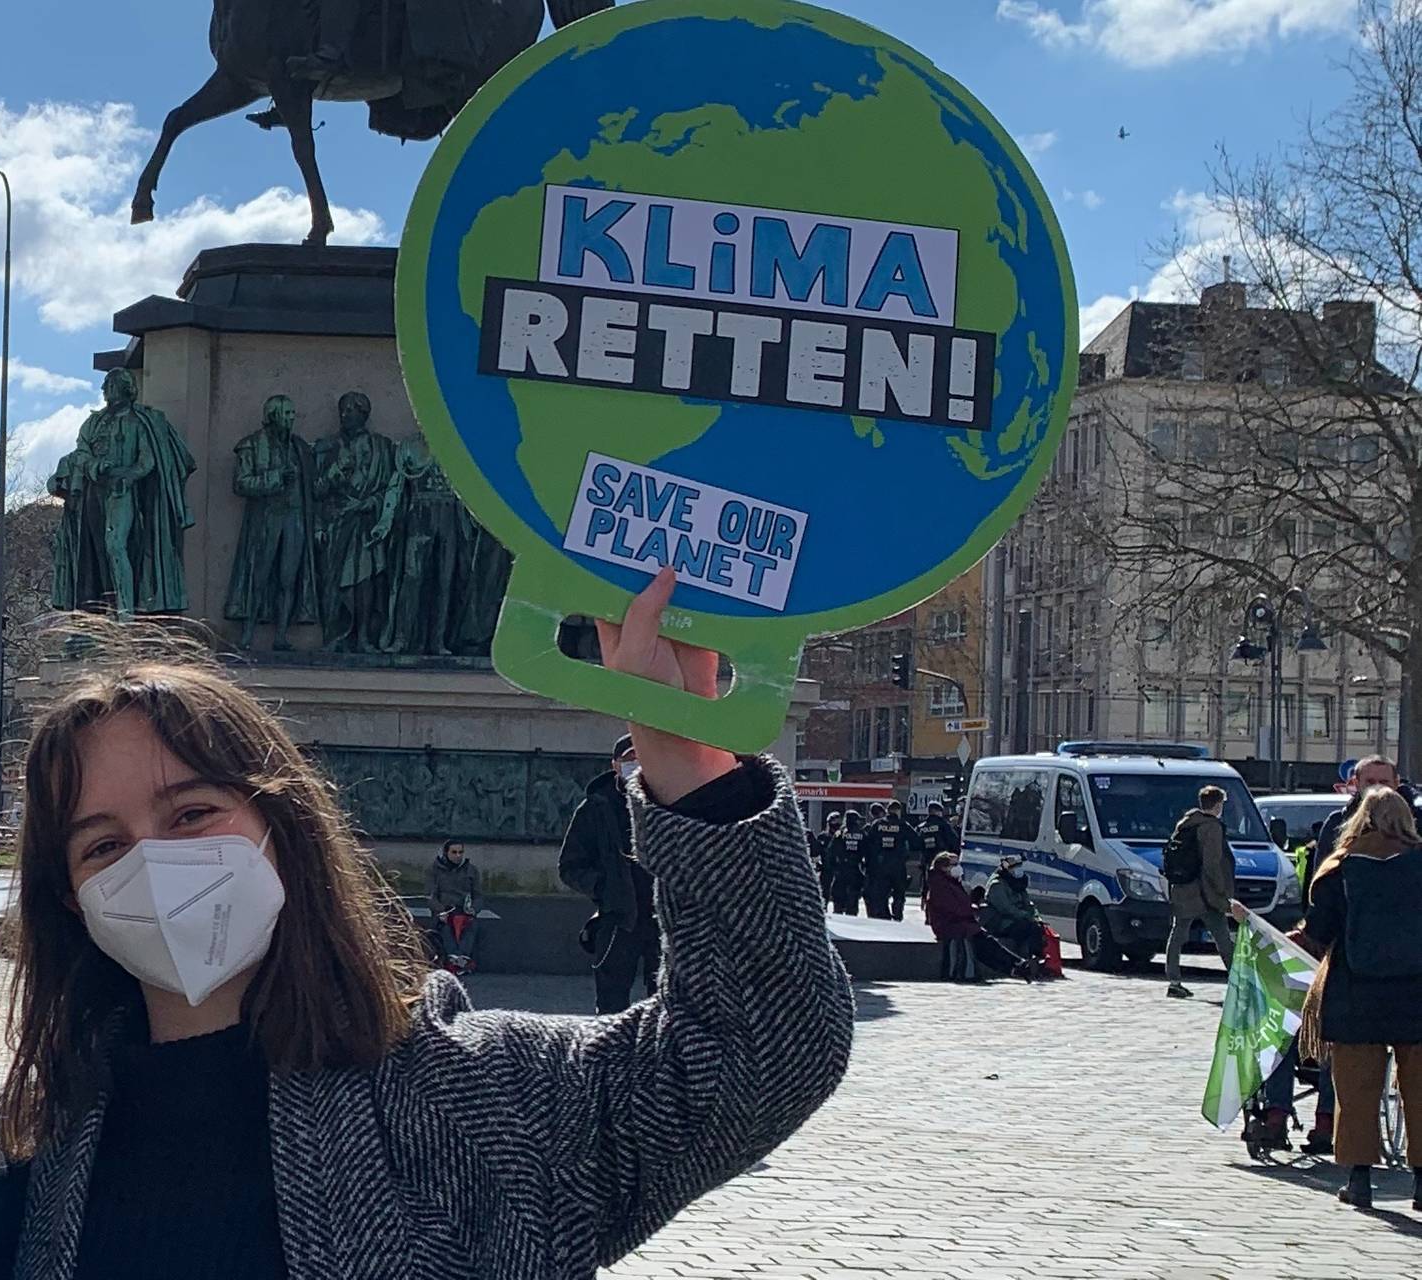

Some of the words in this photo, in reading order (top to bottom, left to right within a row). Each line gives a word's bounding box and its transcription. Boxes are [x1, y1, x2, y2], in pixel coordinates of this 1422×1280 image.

[497, 288, 978, 423] RETTEN!
[585, 508, 778, 597] PLANET
[586, 463, 701, 532] SAVE
[717, 500, 797, 560] OUR
[796, 788, 828, 796] umarkt
